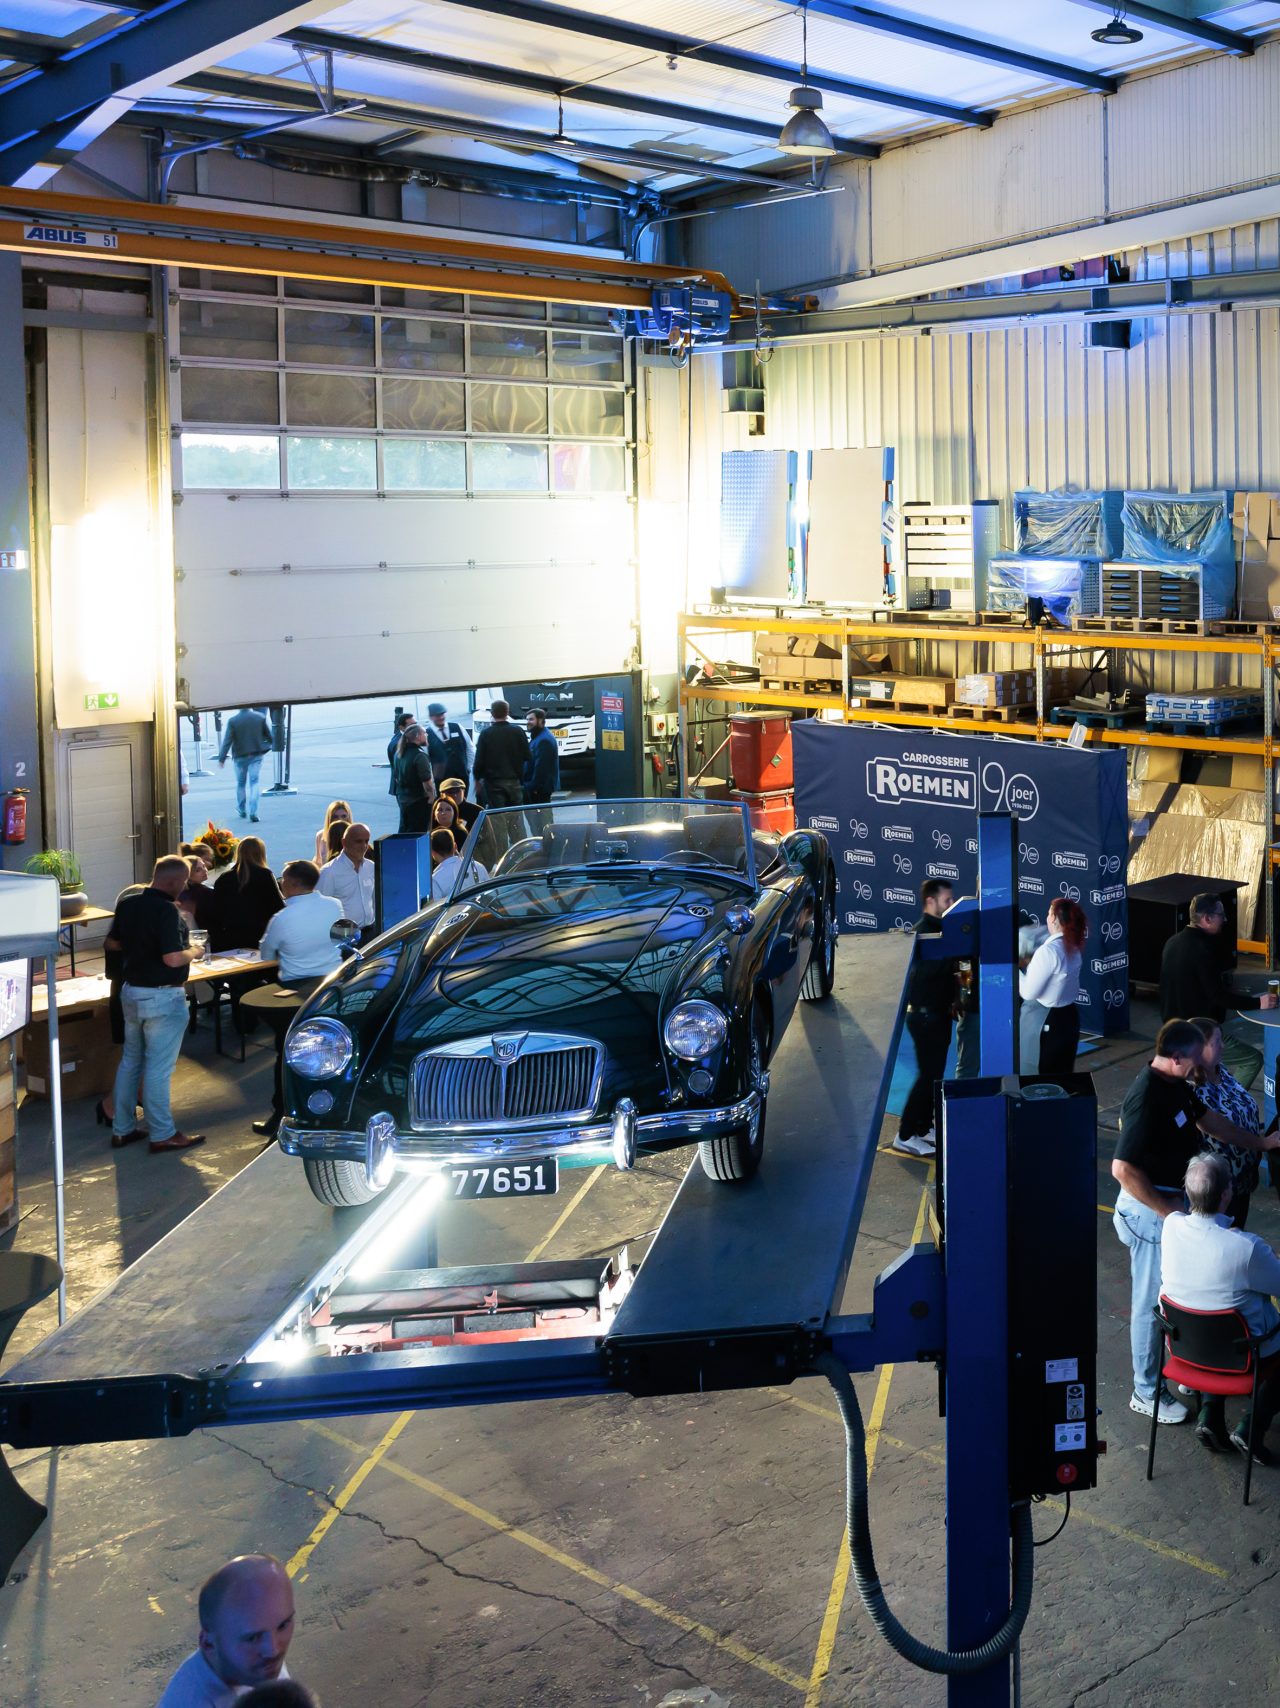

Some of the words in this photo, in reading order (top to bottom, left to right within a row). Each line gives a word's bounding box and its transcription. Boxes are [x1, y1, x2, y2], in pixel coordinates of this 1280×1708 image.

[26, 227, 87, 245] ABUS
[530, 692, 574, 702] MAN
[902, 752, 969, 768] CARROSSERIE
[15, 762, 26, 777] 2
[876, 764, 969, 799] ROEMEN
[1010, 785, 1034, 802] joer
[811, 818, 838, 830] ROEMEN
[884, 828, 912, 840] ROEMEN
[846, 852, 874, 864] ROEMEN
[1055, 854, 1086, 867] ROEMEN
[928, 865, 957, 877] ROEMEN
[1018, 881, 1042, 892] OEMEN
[885, 890, 914, 903] ROEMEN
[848, 914, 876, 926] ROEMEN
[1094, 957, 1126, 973] ROEMEN
[451, 1165, 547, 1196] 77651
